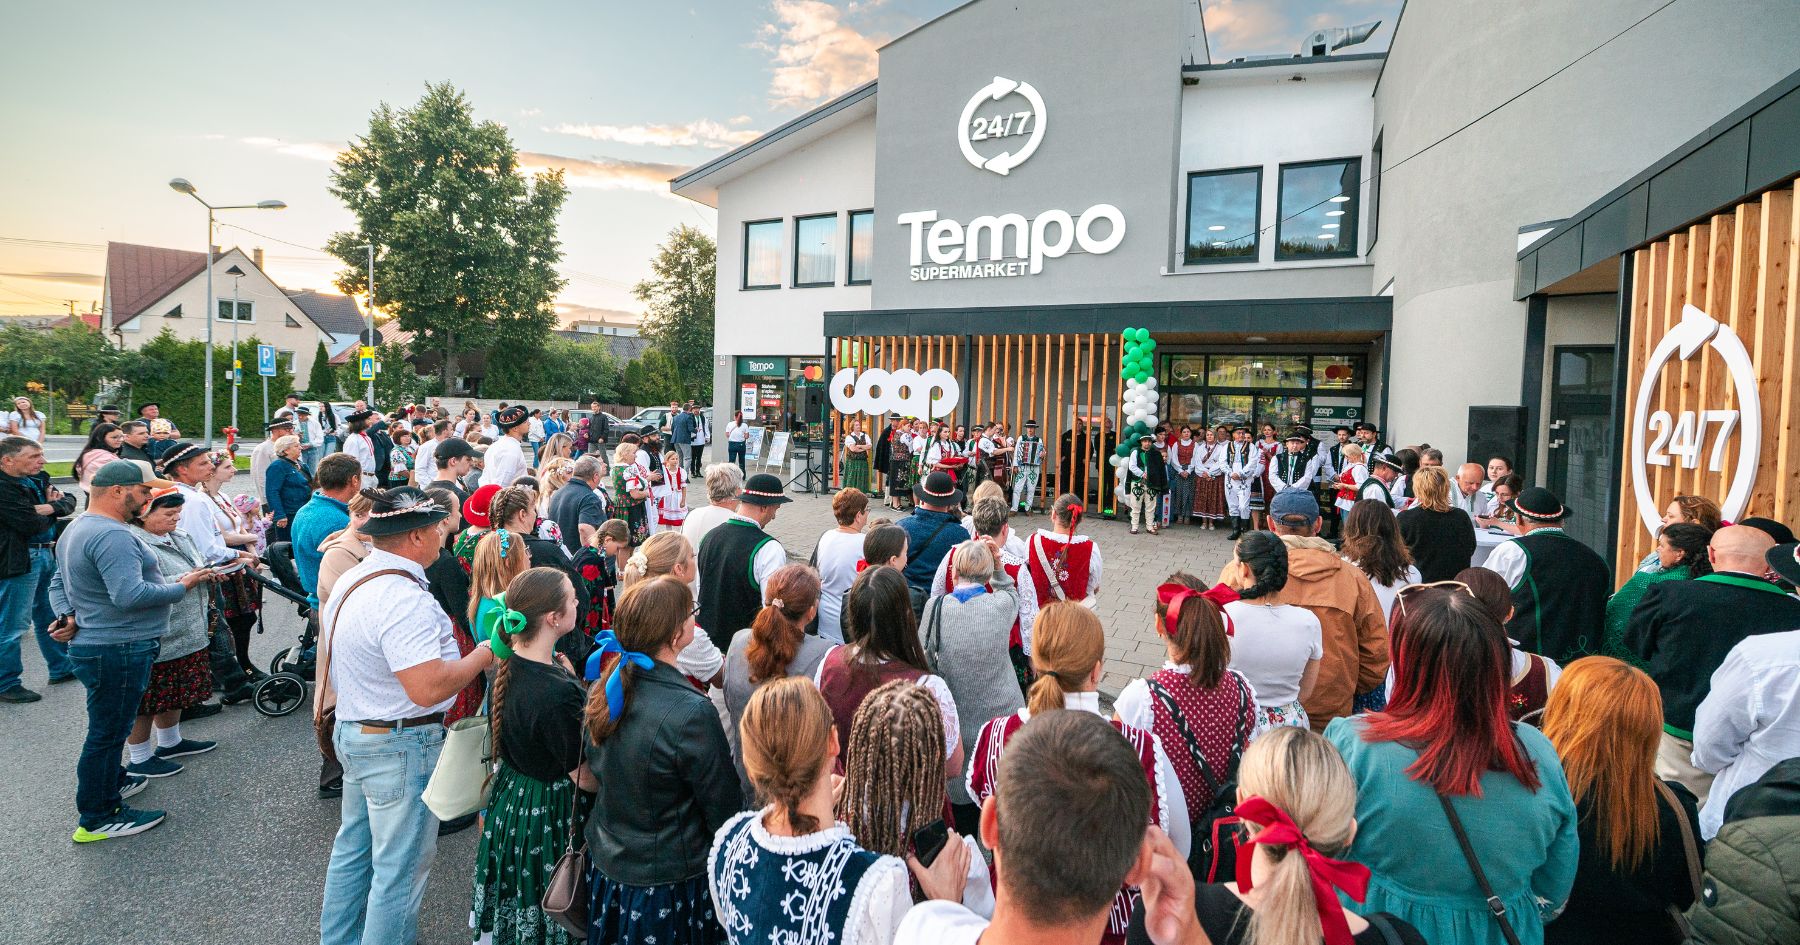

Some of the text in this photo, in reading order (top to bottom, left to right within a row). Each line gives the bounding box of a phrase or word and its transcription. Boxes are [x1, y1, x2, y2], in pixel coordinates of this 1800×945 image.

[972, 111, 1031, 141] 24/7
[898, 203, 1127, 275] Tempo
[910, 261, 1029, 281] SUPERMARKET
[263, 348, 271, 364] P
[748, 361, 775, 372] Tempo
[1646, 409, 1740, 471] 24/7
